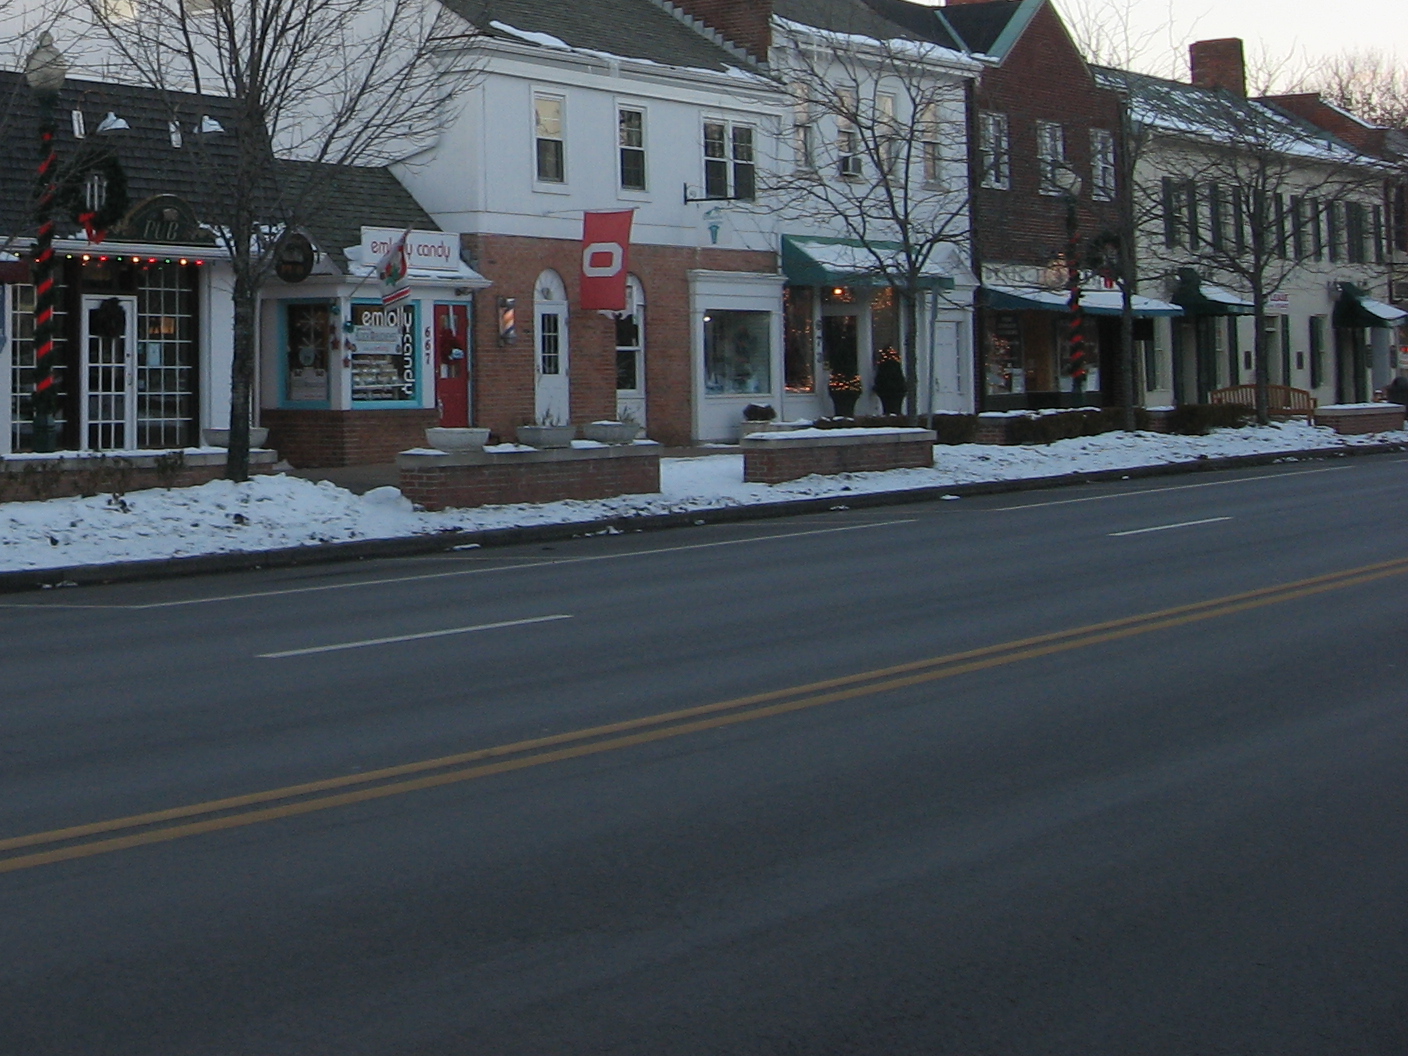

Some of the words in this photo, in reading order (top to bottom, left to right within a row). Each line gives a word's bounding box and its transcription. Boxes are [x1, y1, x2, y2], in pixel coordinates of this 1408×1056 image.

[143, 219, 179, 240] PUB
[371, 237, 412, 260] emly
[417, 241, 451, 262] candy
[583, 242, 623, 277] O
[362, 306, 412, 333] emlolly
[401, 334, 415, 394] candy
